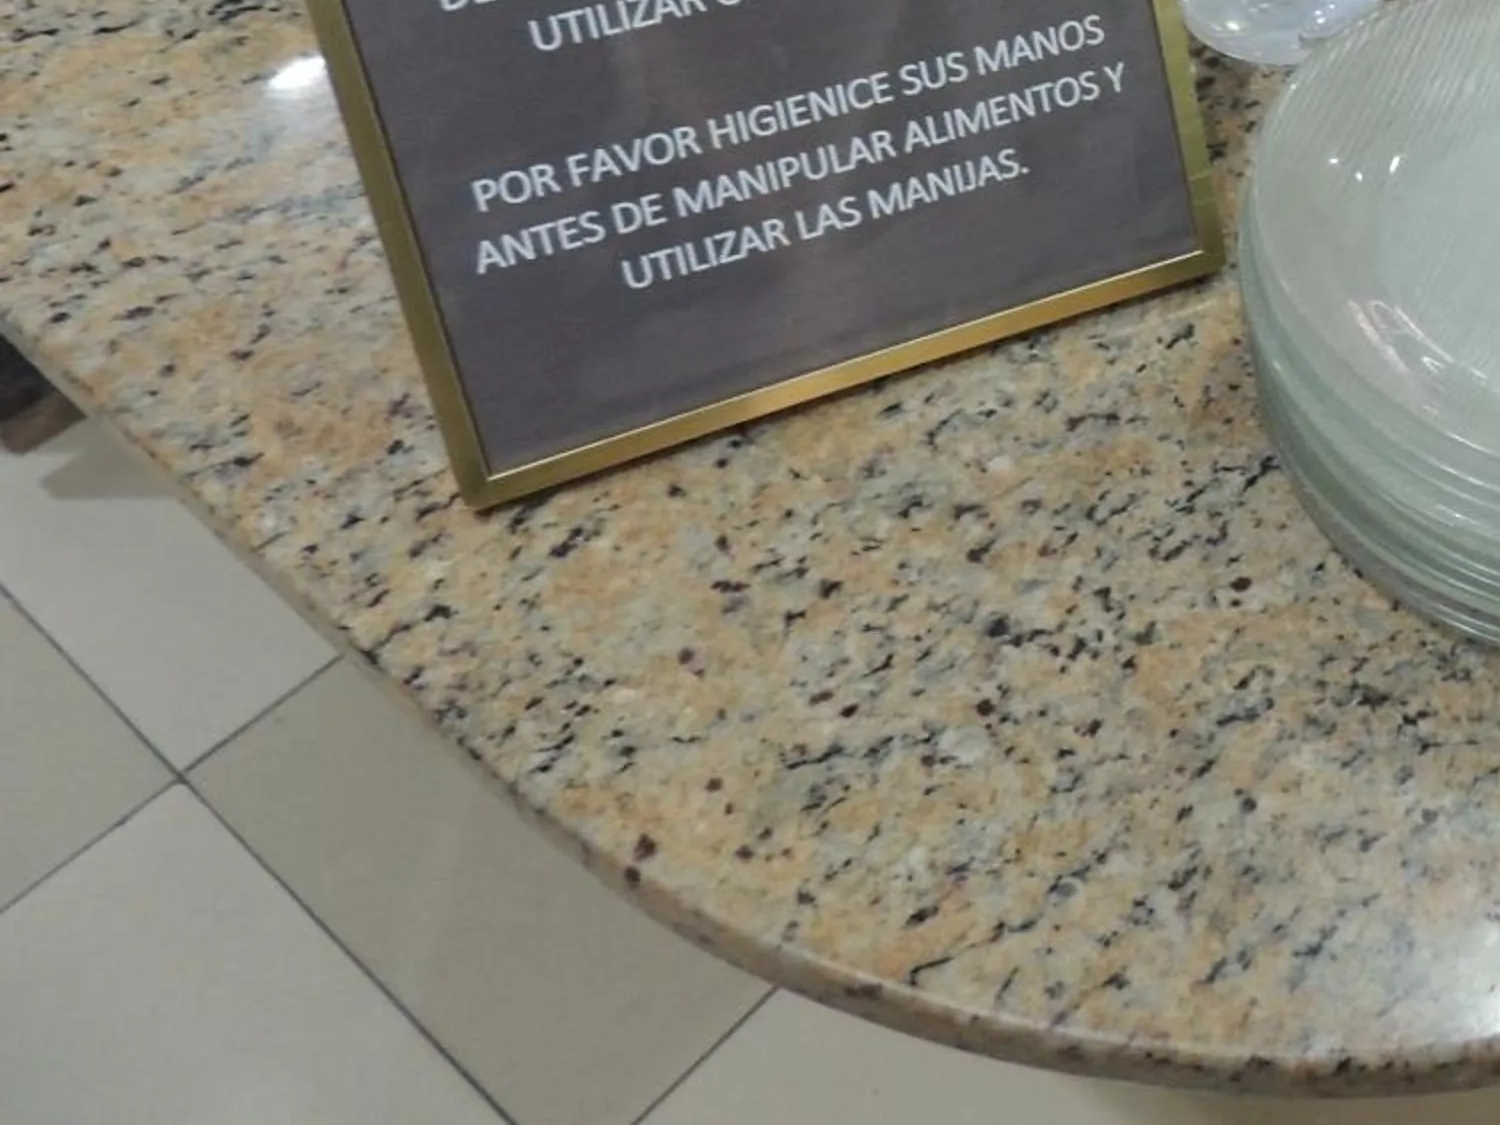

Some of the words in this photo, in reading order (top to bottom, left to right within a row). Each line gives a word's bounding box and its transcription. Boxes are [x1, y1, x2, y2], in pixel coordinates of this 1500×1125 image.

[471, 163, 562, 212] POR
[566, 125, 702, 184] FAVOR
[707, 72, 895, 150] HIGIENICE
[899, 51, 969, 97] SUS
[974, 14, 1107, 74] MANOS
[475, 217, 606, 275] ANTES
[611, 194, 667, 236] DE
[672, 129, 898, 219] MANIPULAR
[904, 71, 1101, 153] ALIMENTOS
[1103, 61, 1127, 94] Y
[622, 218, 791, 289] UTILIZAR
[795, 196, 862, 240] LAS
[868, 147, 1030, 220] MANIJAS.
